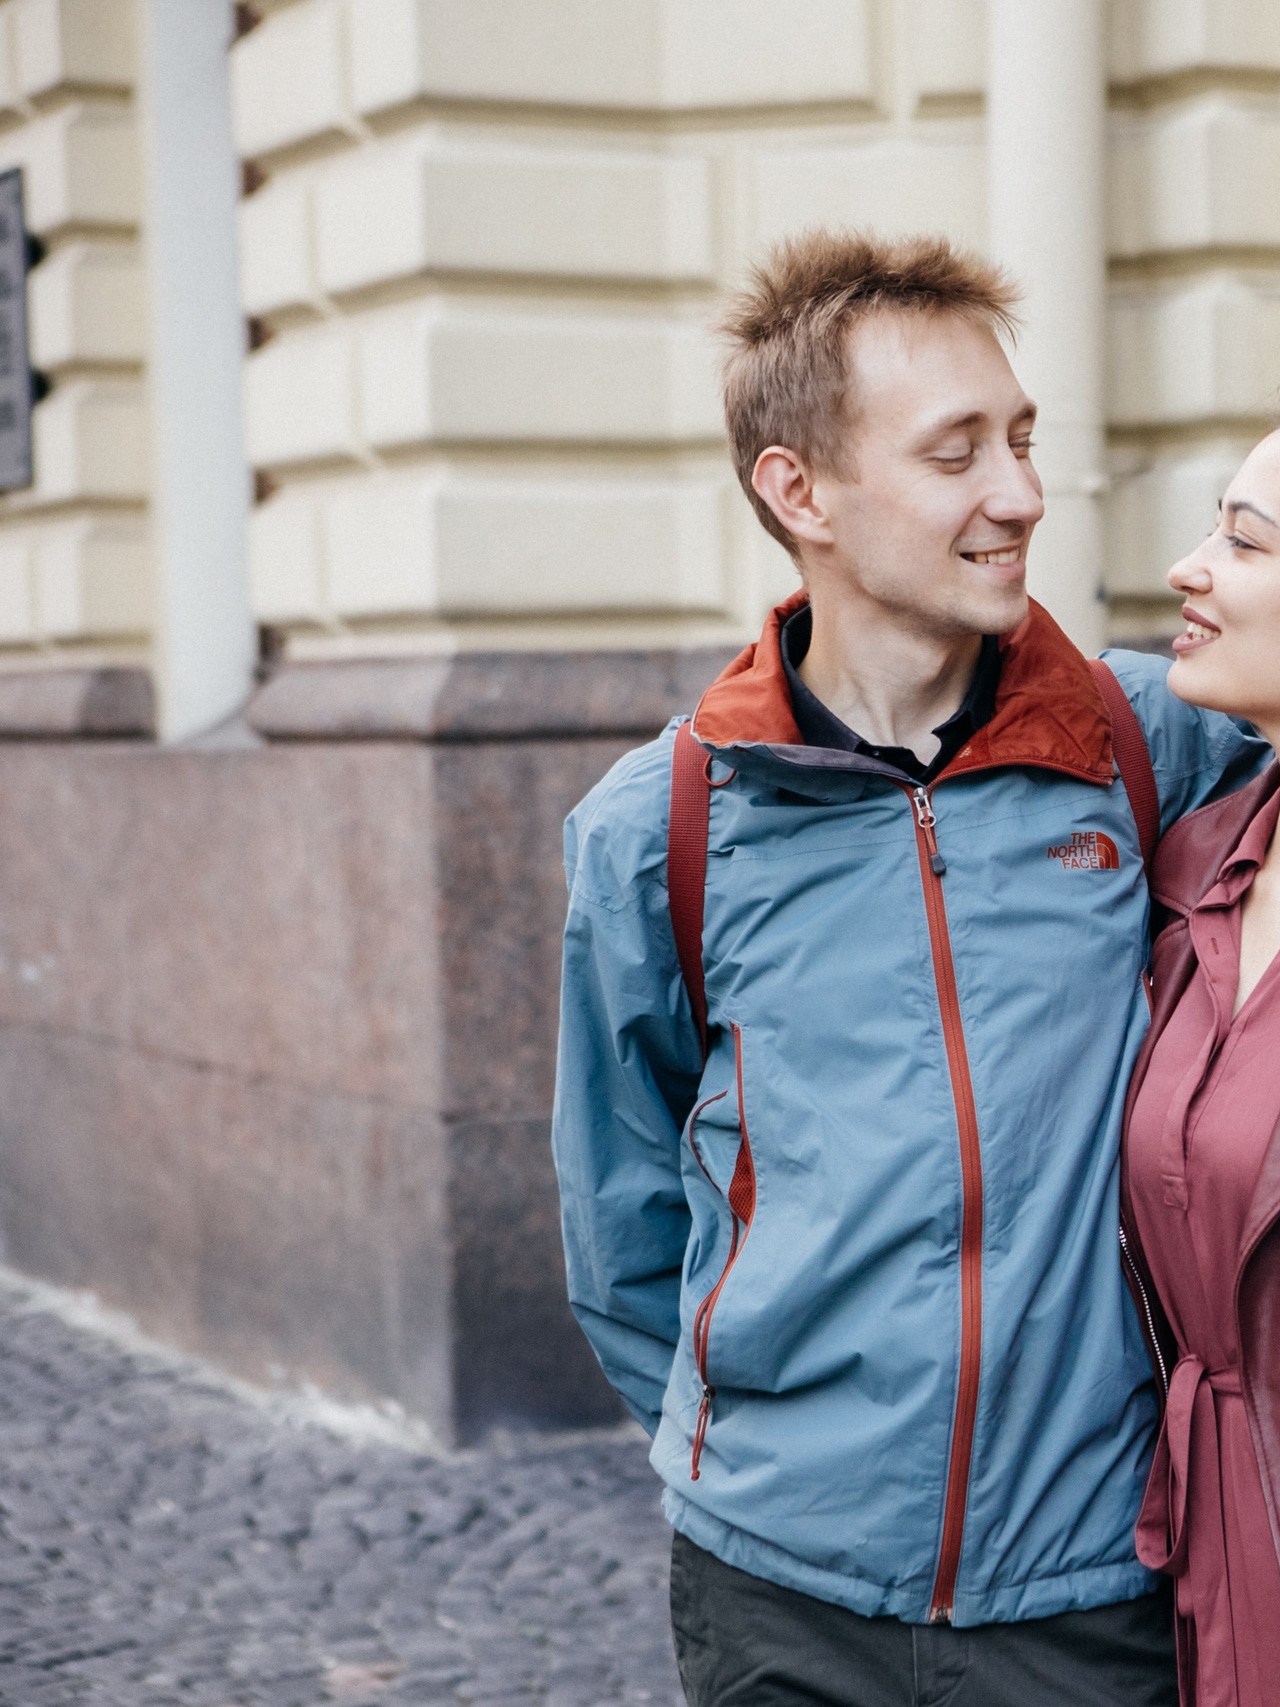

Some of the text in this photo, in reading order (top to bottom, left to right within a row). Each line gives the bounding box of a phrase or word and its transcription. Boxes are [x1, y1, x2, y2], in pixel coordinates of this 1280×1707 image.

[1070, 832, 1096, 845] THE
[1047, 844, 1098, 859] NORTH
[1061, 856, 1099, 870] FACE
